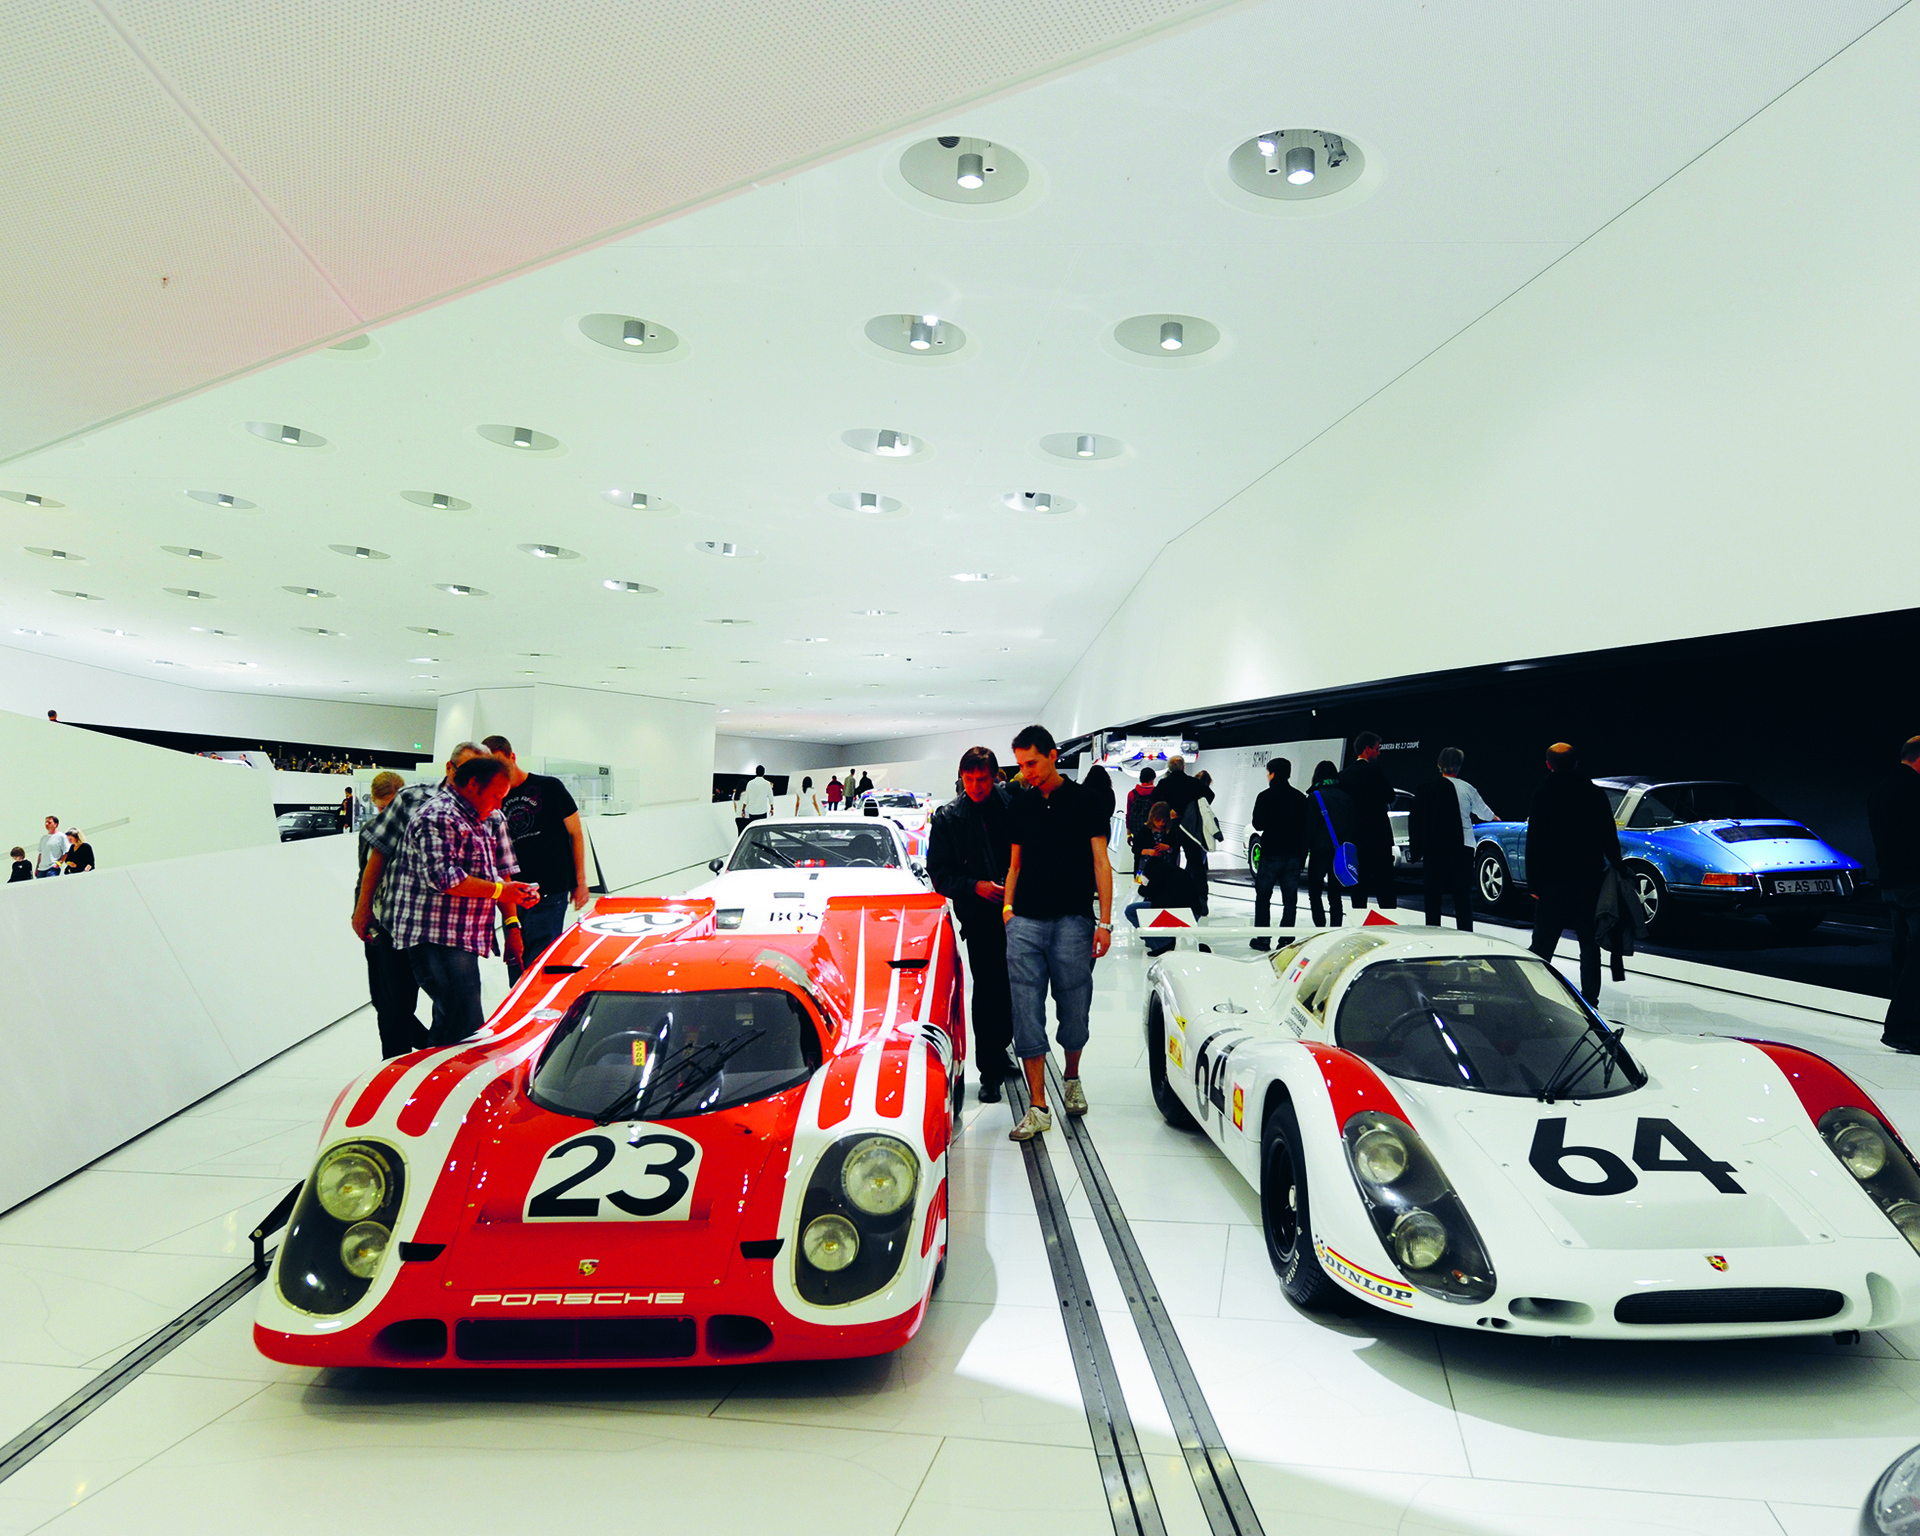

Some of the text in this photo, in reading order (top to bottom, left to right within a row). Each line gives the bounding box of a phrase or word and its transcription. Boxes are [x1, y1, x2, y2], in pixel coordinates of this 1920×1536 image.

[1814, 880, 1830, 891] 100
[769, 912, 824, 922] BOS
[1528, 1116, 1748, 1197] 64
[527, 1133, 696, 1218] 23
[1325, 1254, 1413, 1300] DUNLOP
[471, 1292, 685, 1307] PORSCHE
